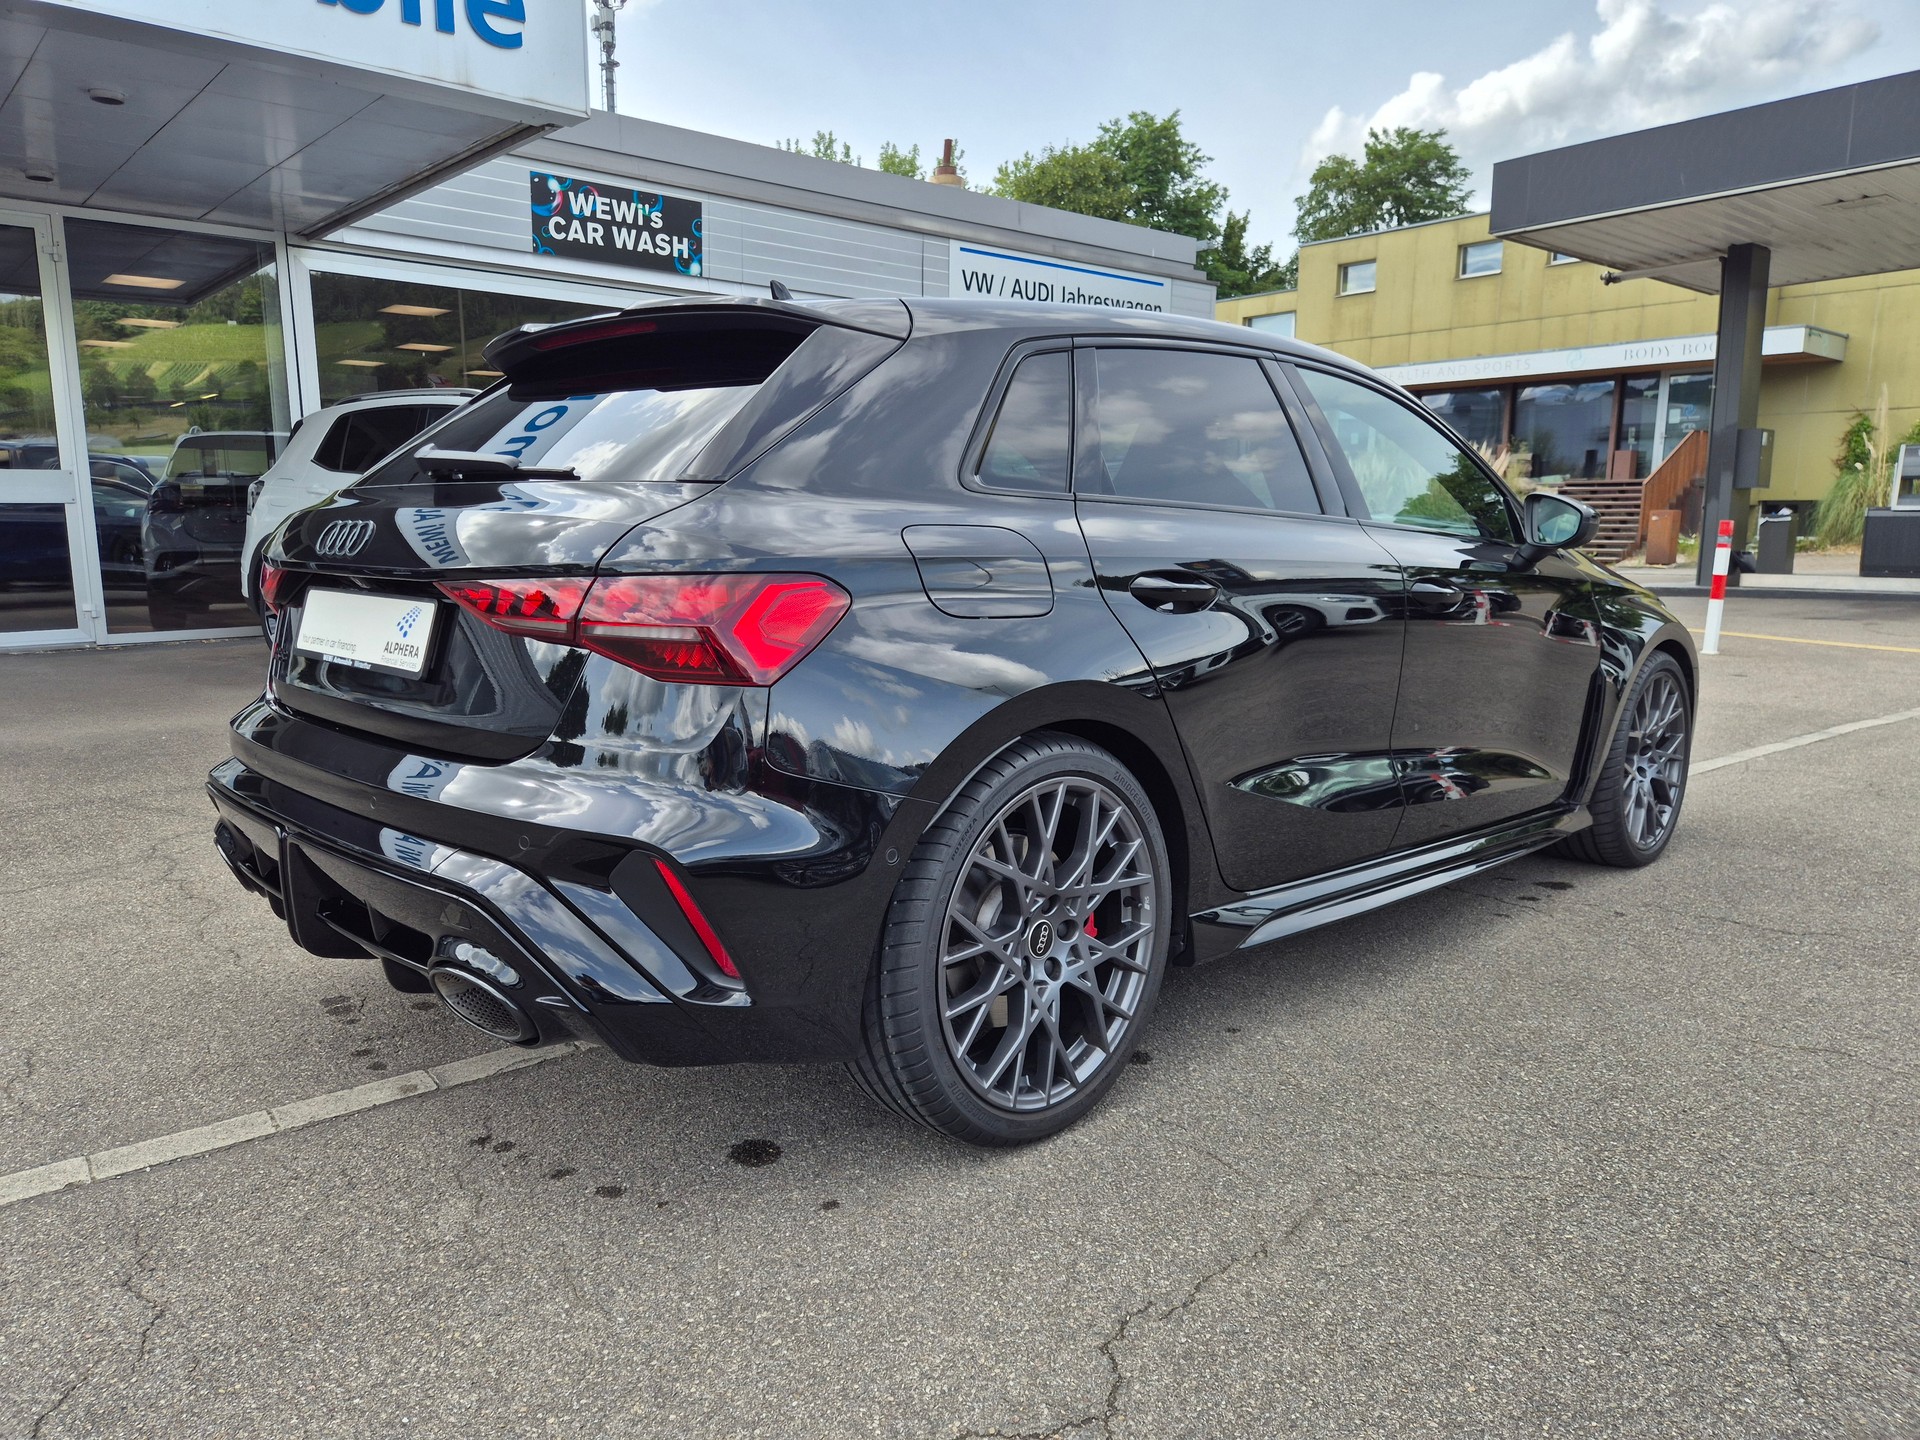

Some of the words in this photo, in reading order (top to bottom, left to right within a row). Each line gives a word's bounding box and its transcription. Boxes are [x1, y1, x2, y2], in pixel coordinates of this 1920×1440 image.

[568, 191, 664, 229] WEWi's
[549, 216, 605, 247] CAR
[612, 226, 689, 259] WASH
[962, 269, 995, 295] VW
[999, 276, 1006, 297] /
[1011, 278, 1054, 302] AUDI
[1624, 345, 1673, 361] BODY
[1436, 364, 1468, 378] AND
[1475, 358, 1531, 374] SPORTS
[383, 641, 420, 659] ALPHERA
